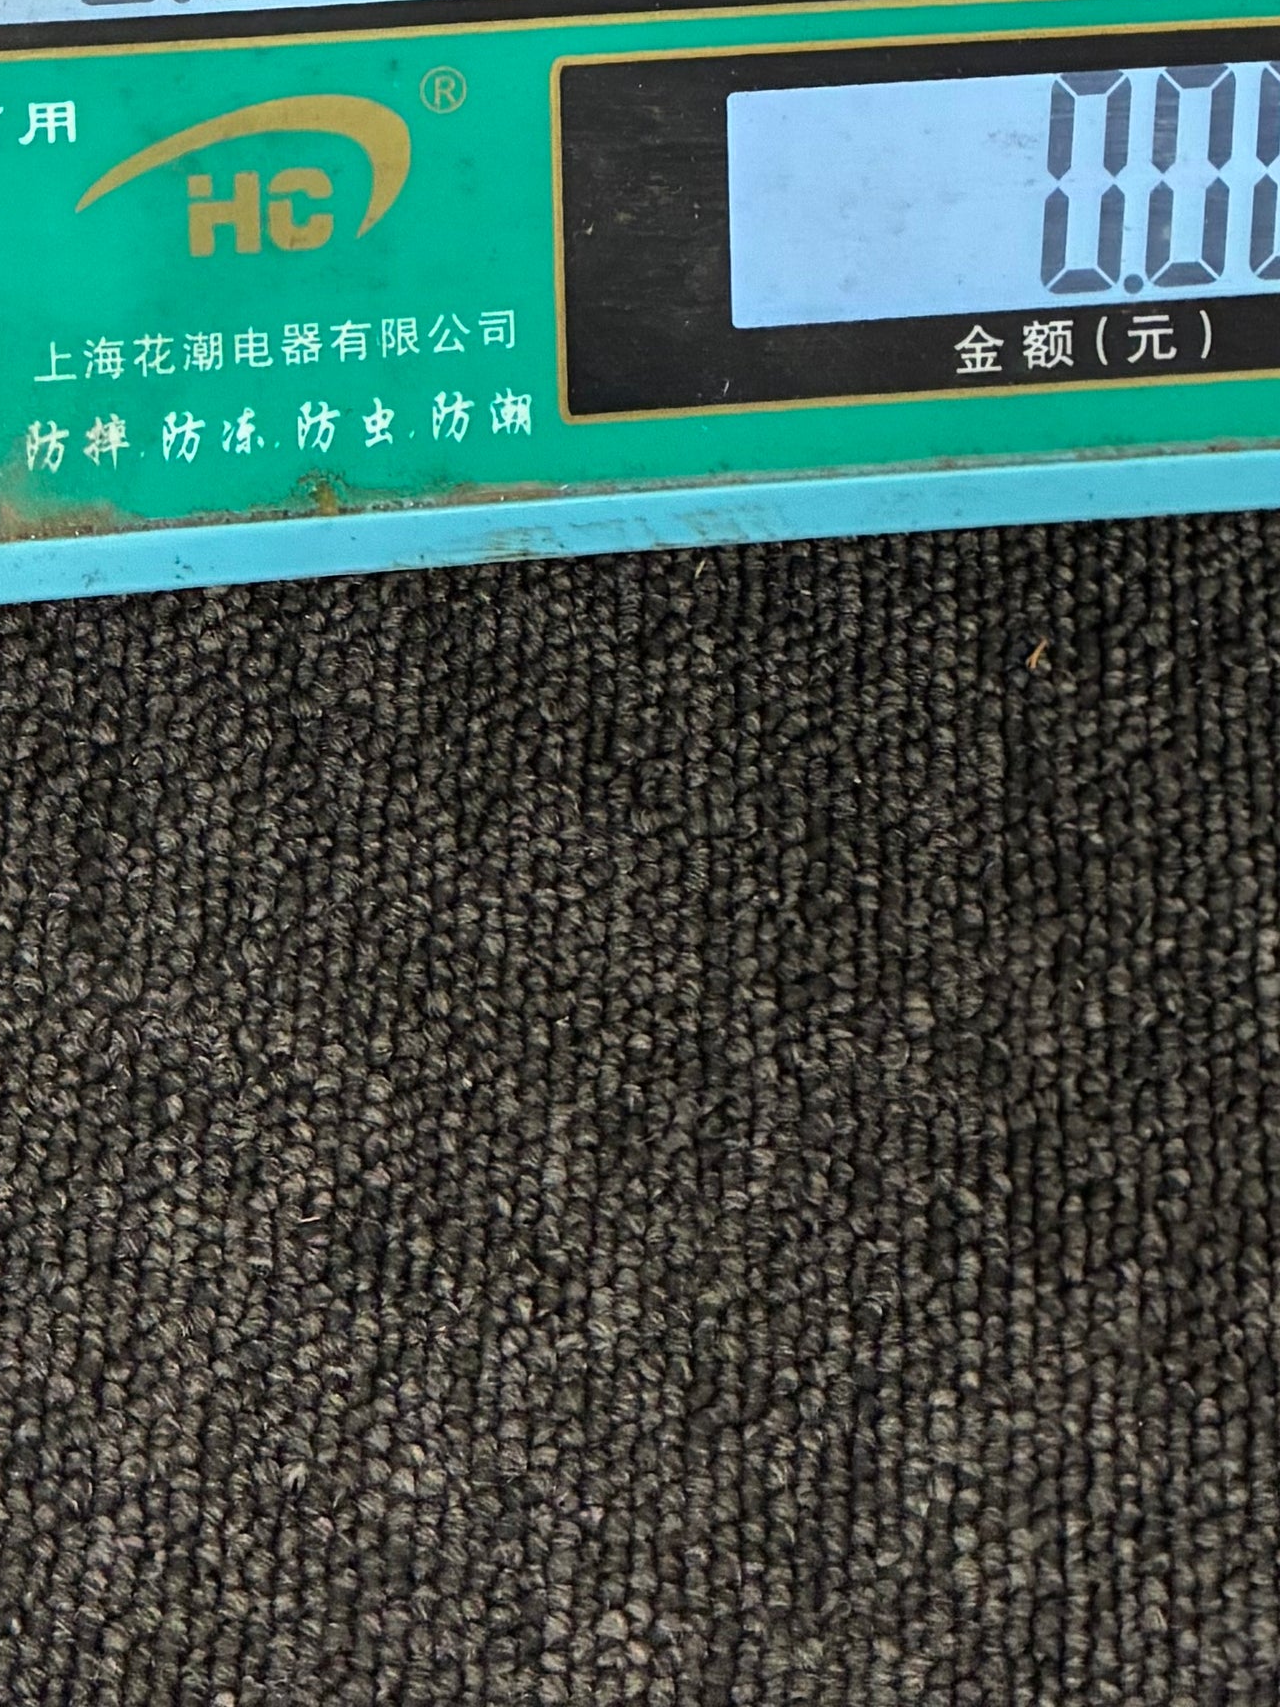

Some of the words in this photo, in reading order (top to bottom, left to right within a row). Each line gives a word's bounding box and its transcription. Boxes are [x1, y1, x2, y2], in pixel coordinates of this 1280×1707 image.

[187, 167, 336, 258] HC
[33, 308, 517, 383] 上海花潮电器有限公司
[954, 308, 1215, 376] 金额(元)
